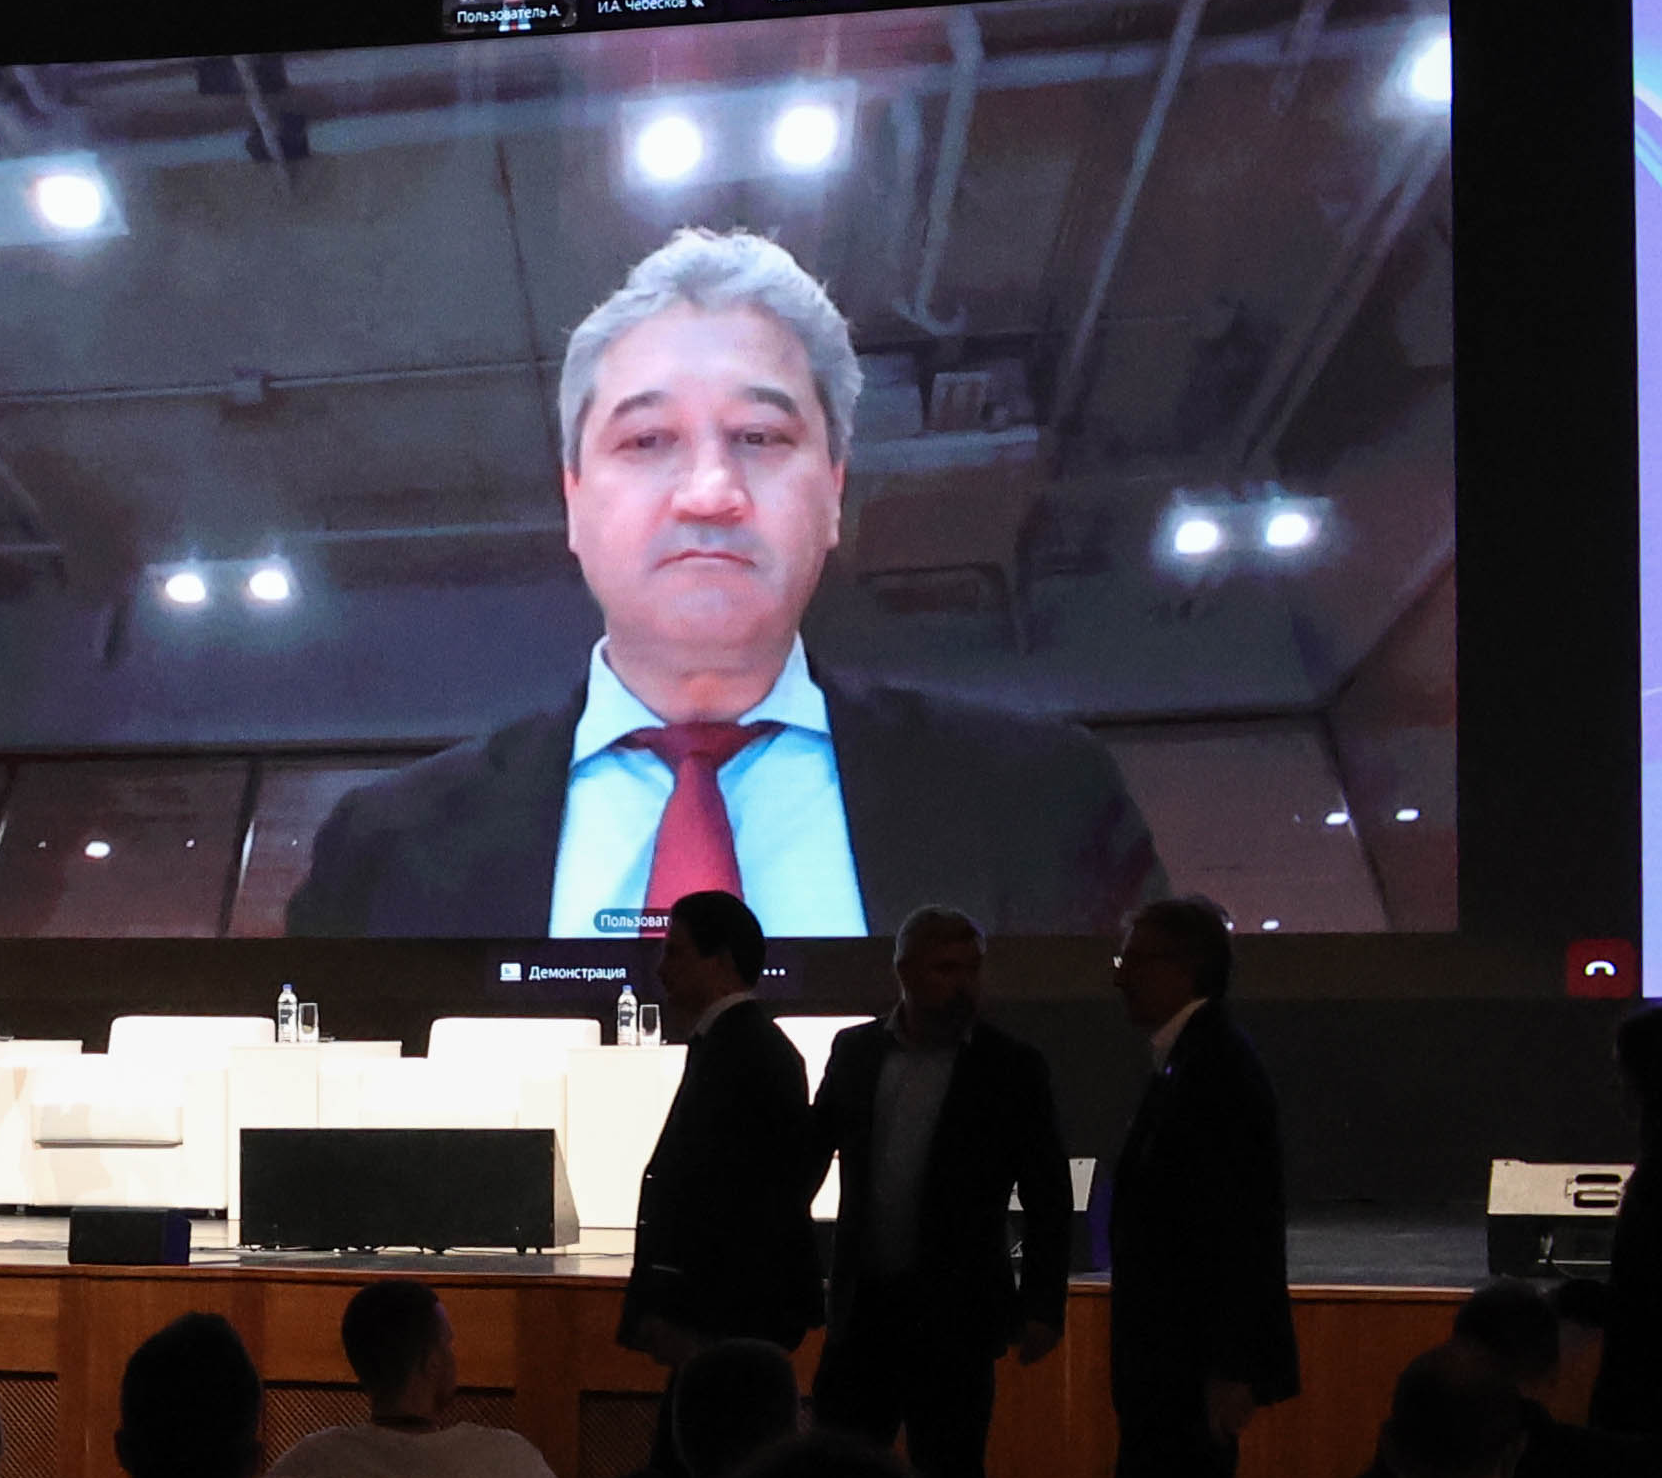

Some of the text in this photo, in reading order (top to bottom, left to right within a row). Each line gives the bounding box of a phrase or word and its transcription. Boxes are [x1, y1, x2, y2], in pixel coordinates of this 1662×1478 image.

[456, 7, 548, 25] Пользователь
[599, 913, 669, 929] Пользоват
[528, 964, 627, 981] Демонстрация
